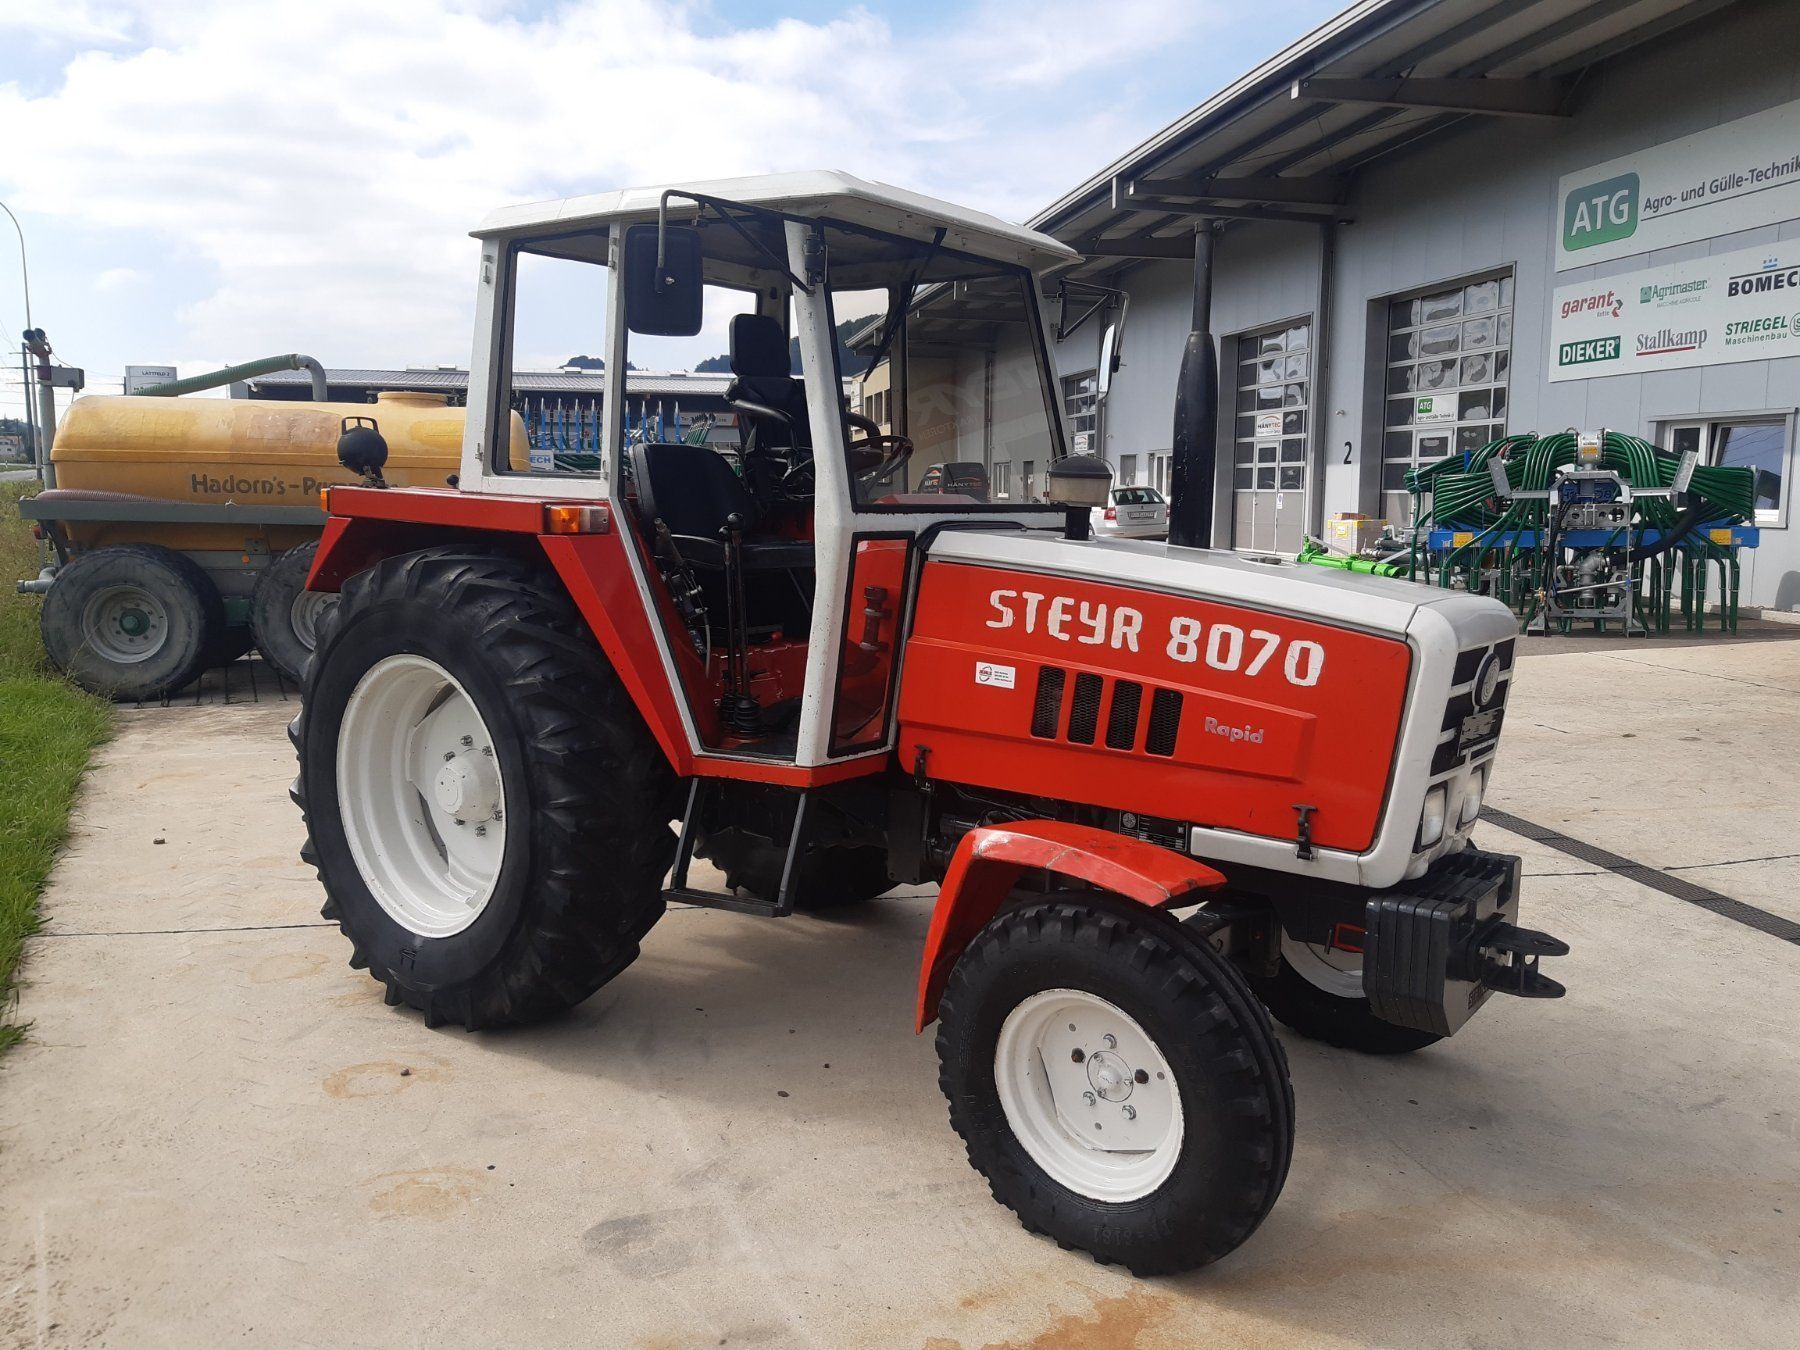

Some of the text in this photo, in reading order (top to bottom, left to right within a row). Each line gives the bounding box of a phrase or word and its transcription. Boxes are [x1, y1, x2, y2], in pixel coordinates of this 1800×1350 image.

[1643, 155, 1800, 214] Agro- und Gülle-Technik
[1570, 189, 1630, 237] ATG
[1652, 279, 1708, 301] Agrimaster
[1728, 270, 1800, 298] BOMEC
[1561, 290, 1615, 319] garant
[1725, 316, 1788, 336] STRIEGEL
[1561, 339, 1616, 364] DIEKER
[1636, 328, 1708, 352] Stallkamp
[1725, 332, 1788, 346] Maschinenbau
[1419, 401, 1432, 410] ATG
[1343, 441, 1353, 465] 2
[985, 588, 1325, 687] STEYR 8070
[1204, 716, 1265, 745] Rapid
